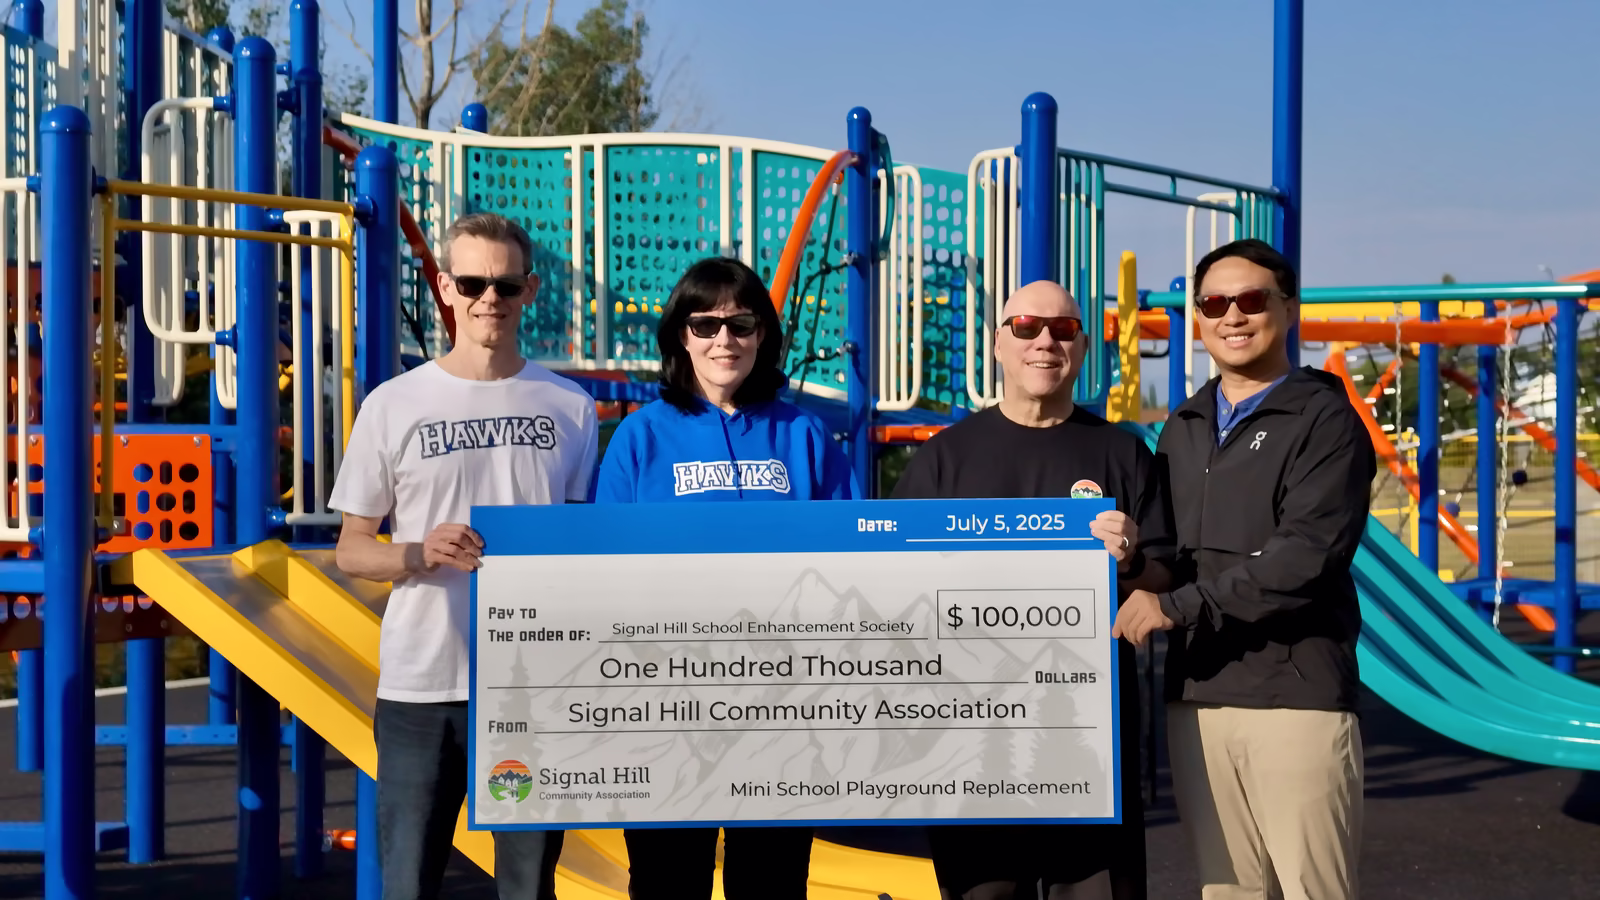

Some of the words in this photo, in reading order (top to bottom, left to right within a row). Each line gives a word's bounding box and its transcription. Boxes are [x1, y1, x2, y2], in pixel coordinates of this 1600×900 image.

[419, 415, 556, 459] HAWKS
[673, 458, 790, 496] HAWKS
[857, 518, 898, 533] Date:
[945, 514, 989, 535] July
[993, 514, 1010, 534] 5,
[1015, 513, 1066, 531] 2025
[612, 622, 660, 637] Signal
[664, 621, 688, 634] Hill
[692, 621, 743, 634] School
[747, 620, 855, 634] Enhancement
[859, 620, 915, 637] Society
[947, 603, 964, 631] $
[971, 605, 1081, 631] 100,000
[599, 657, 659, 679] One
[668, 655, 794, 679] Hundred
[802, 654, 943, 677] Thousand
[568, 701, 650, 727] Signal
[659, 700, 701, 722] Hill
[708, 699, 867, 725] Community
[875, 698, 1027, 720] Association
[539, 767, 606, 789] Signal
[612, 766, 651, 784] Hill
[731, 781, 771, 796] Mini
[776, 780, 840, 796] School
[846, 780, 957, 799] Playground
[963, 779, 1091, 799] Replacement
[539, 790, 593, 802] Community
[595, 790, 651, 800] Association
